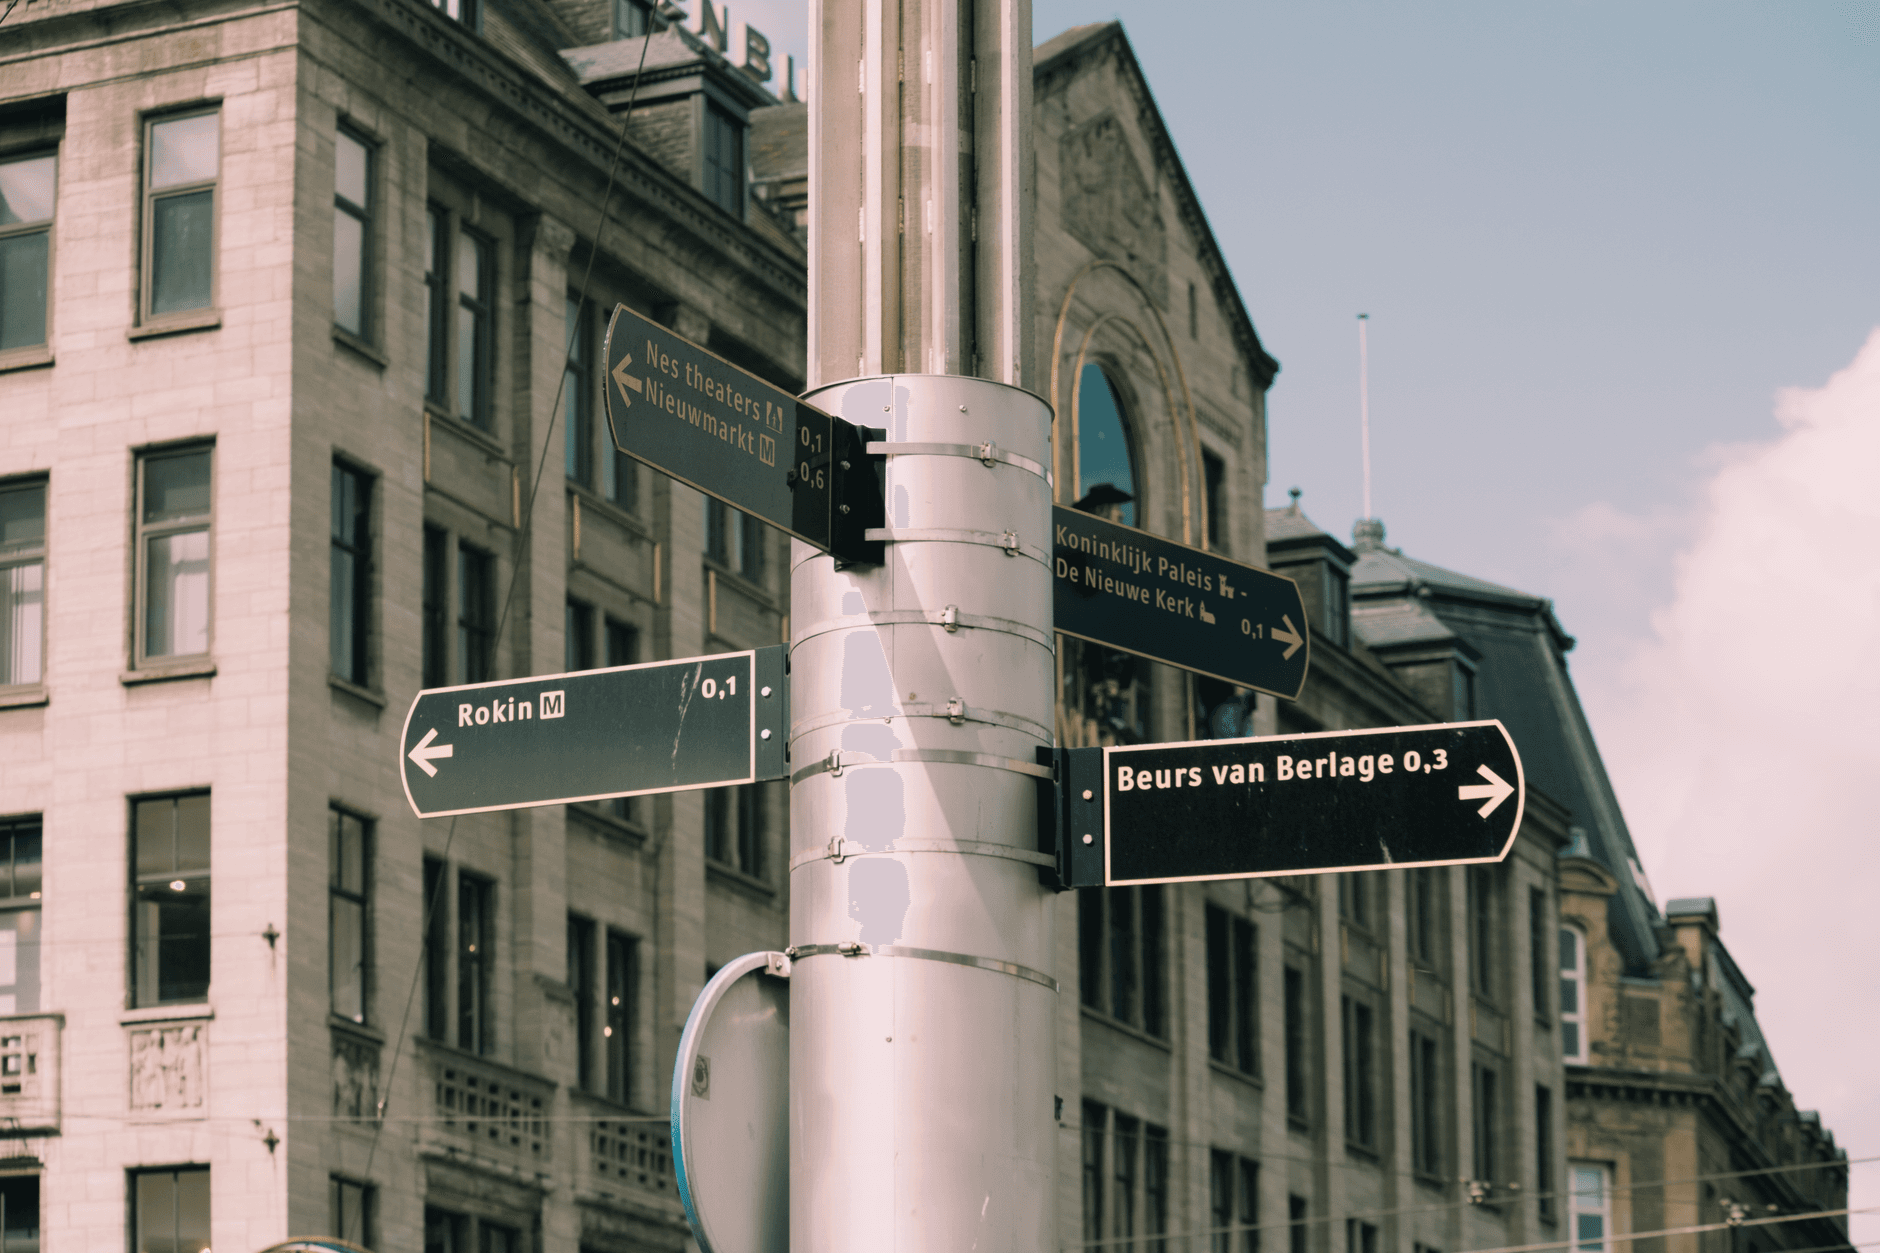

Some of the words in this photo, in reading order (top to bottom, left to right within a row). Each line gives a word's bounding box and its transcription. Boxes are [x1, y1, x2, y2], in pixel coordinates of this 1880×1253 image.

[645, 376, 755, 455] Nieuwmarkt
[801, 461, 824, 490] 0,6
[646, 339, 680, 379] Nes
[685, 362, 761, 421] theaters
[801, 425, 822, 453] 0,1
[1056, 523, 1152, 574] Koninklijk
[1158, 556, 1212, 591] Paleis
[1056, 557, 1079, 583] De
[1085, 566, 1150, 605] Nieuwe
[1156, 588, 1194, 618] Kerk
[1241, 618, 1263, 640] 0,1
[458, 697, 532, 728] Rokin
[701, 675, 737, 701] 0,1
[1117, 765, 1201, 791] Beurs
[1212, 762, 1264, 785] van
[1277, 751, 1394, 782] Berlage
[1403, 749, 1448, 774] 0,3
